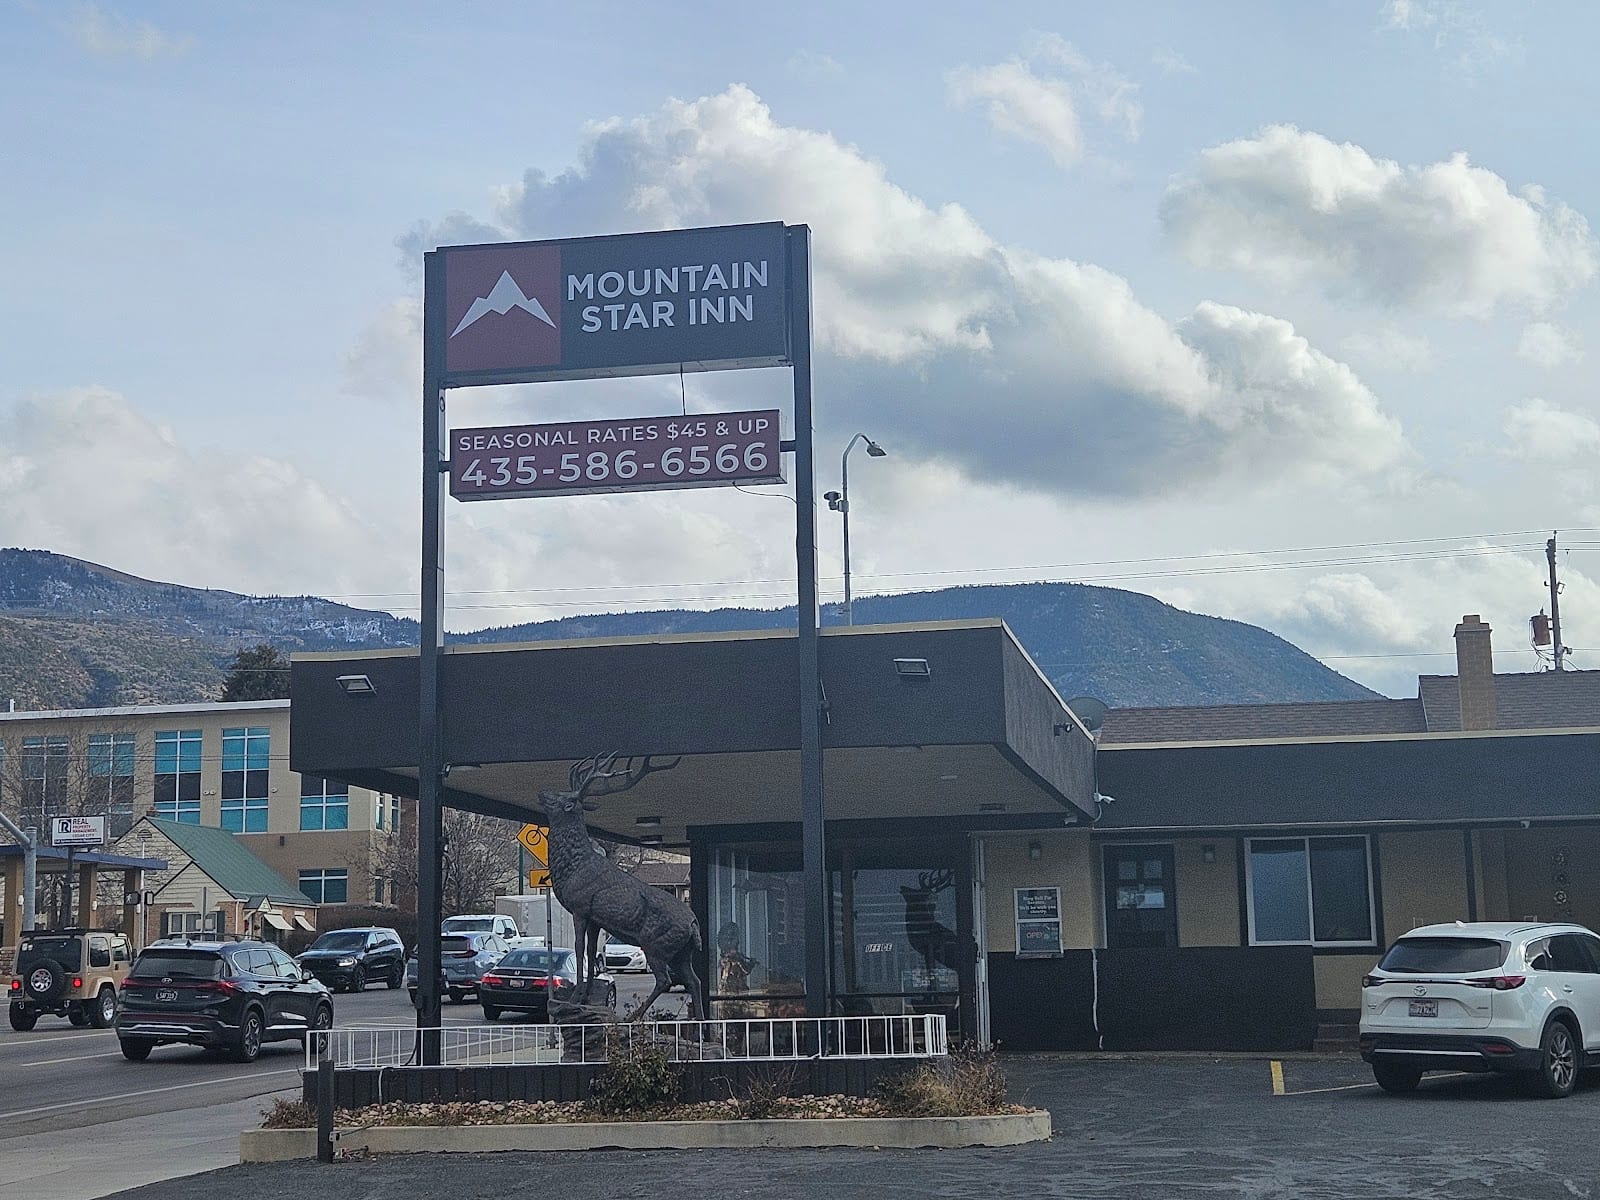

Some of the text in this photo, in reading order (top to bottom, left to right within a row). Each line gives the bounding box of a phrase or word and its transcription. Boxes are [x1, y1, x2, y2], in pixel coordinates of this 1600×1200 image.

[567, 261, 768, 301] MOUNTAIN
[581, 295, 753, 333] STAR INN
[459, 418, 769, 451] SEASONAL RATES $45 & UP
[461, 442, 768, 488] 435-586-6566
[865, 943, 893, 953] OFFICE
